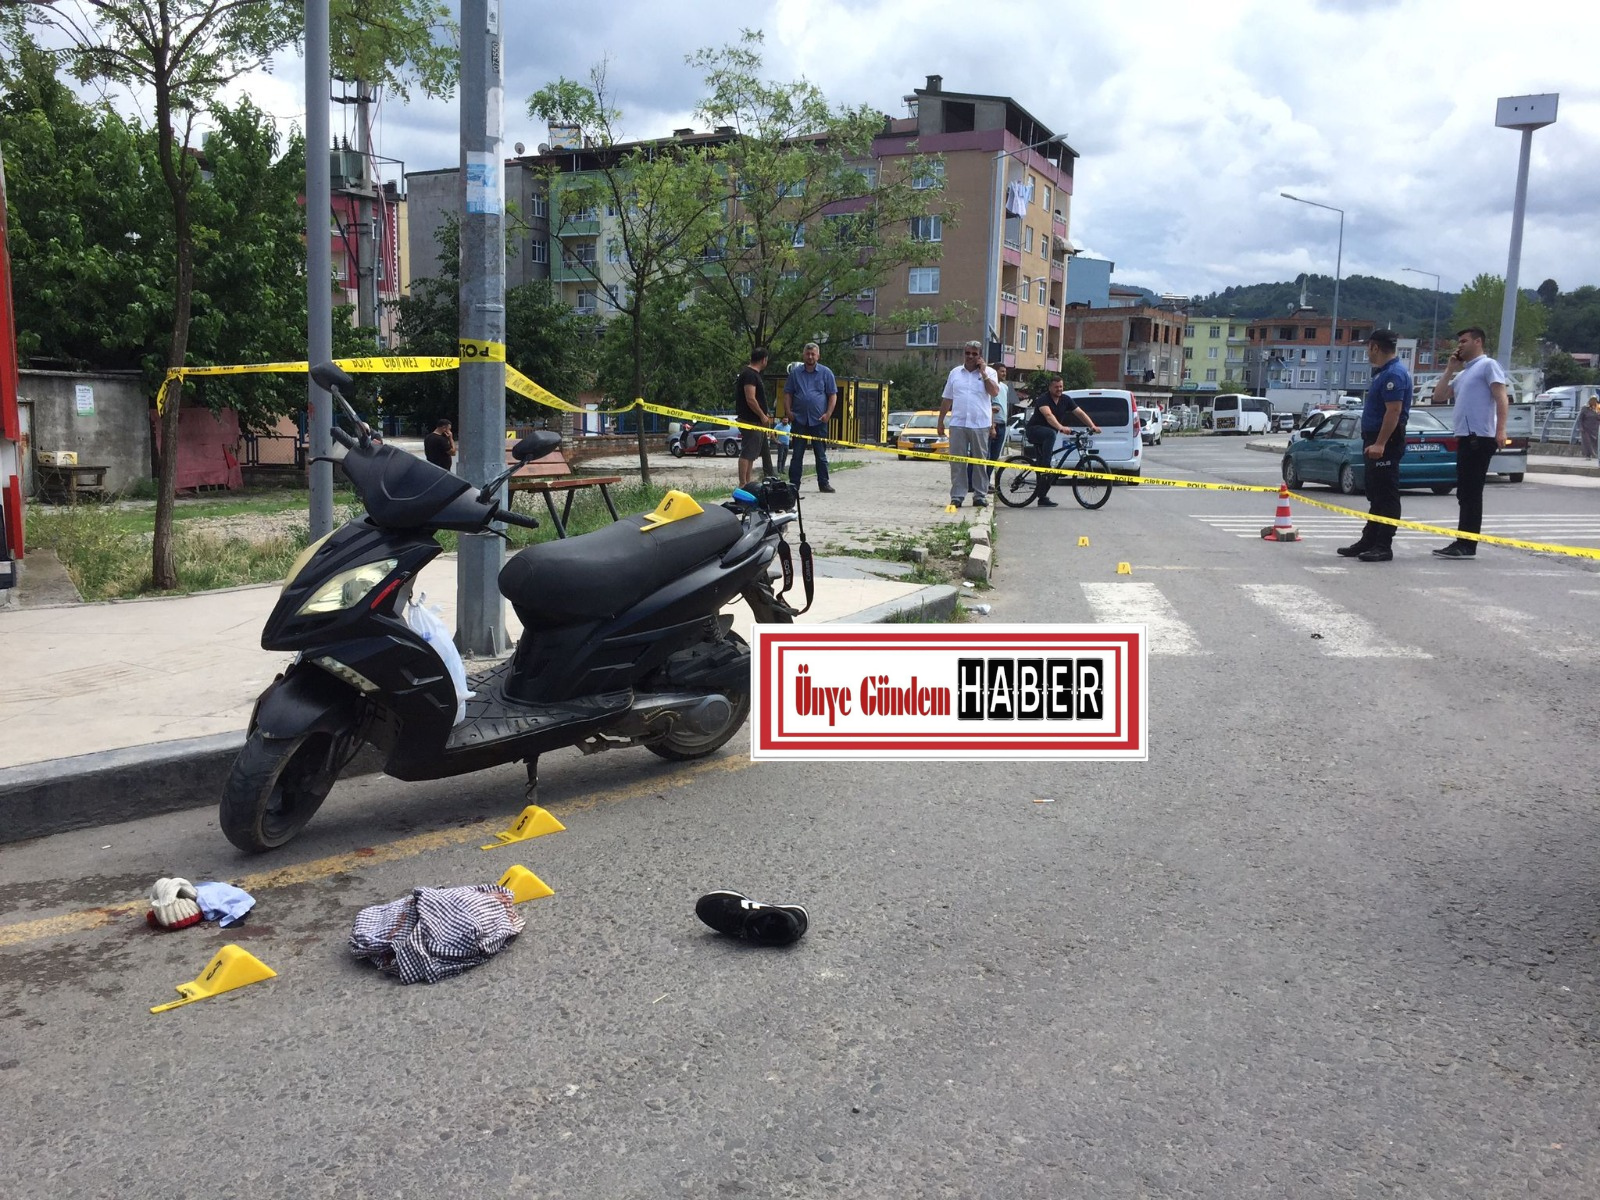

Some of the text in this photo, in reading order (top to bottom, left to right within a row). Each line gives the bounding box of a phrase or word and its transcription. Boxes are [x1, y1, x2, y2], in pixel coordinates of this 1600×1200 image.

[664, 498, 674, 511] 6
[517, 815, 528, 830] 5
[206, 960, 223, 981] 3
